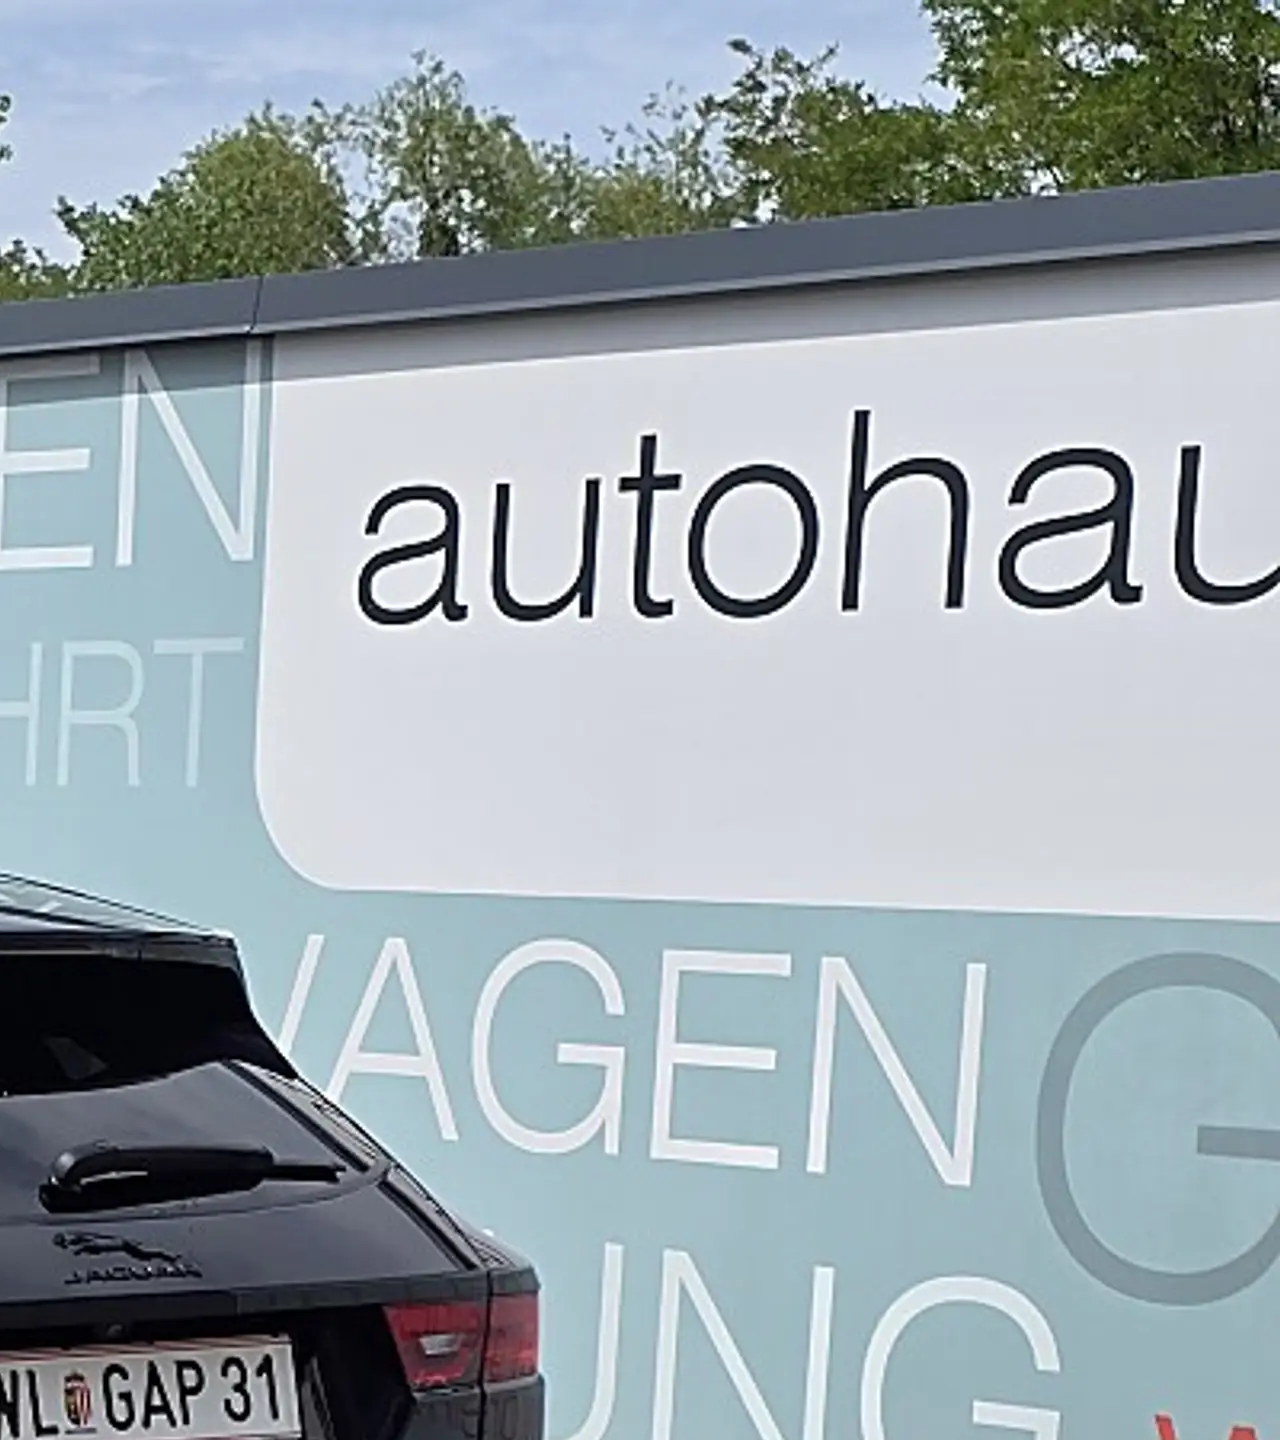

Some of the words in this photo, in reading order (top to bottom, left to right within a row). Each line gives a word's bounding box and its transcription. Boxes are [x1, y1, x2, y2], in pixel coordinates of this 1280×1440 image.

[278, 933, 987, 1187] AGEN
[102, 1358, 207, 1433] GAP
[220, 1353, 280, 1424] 31
